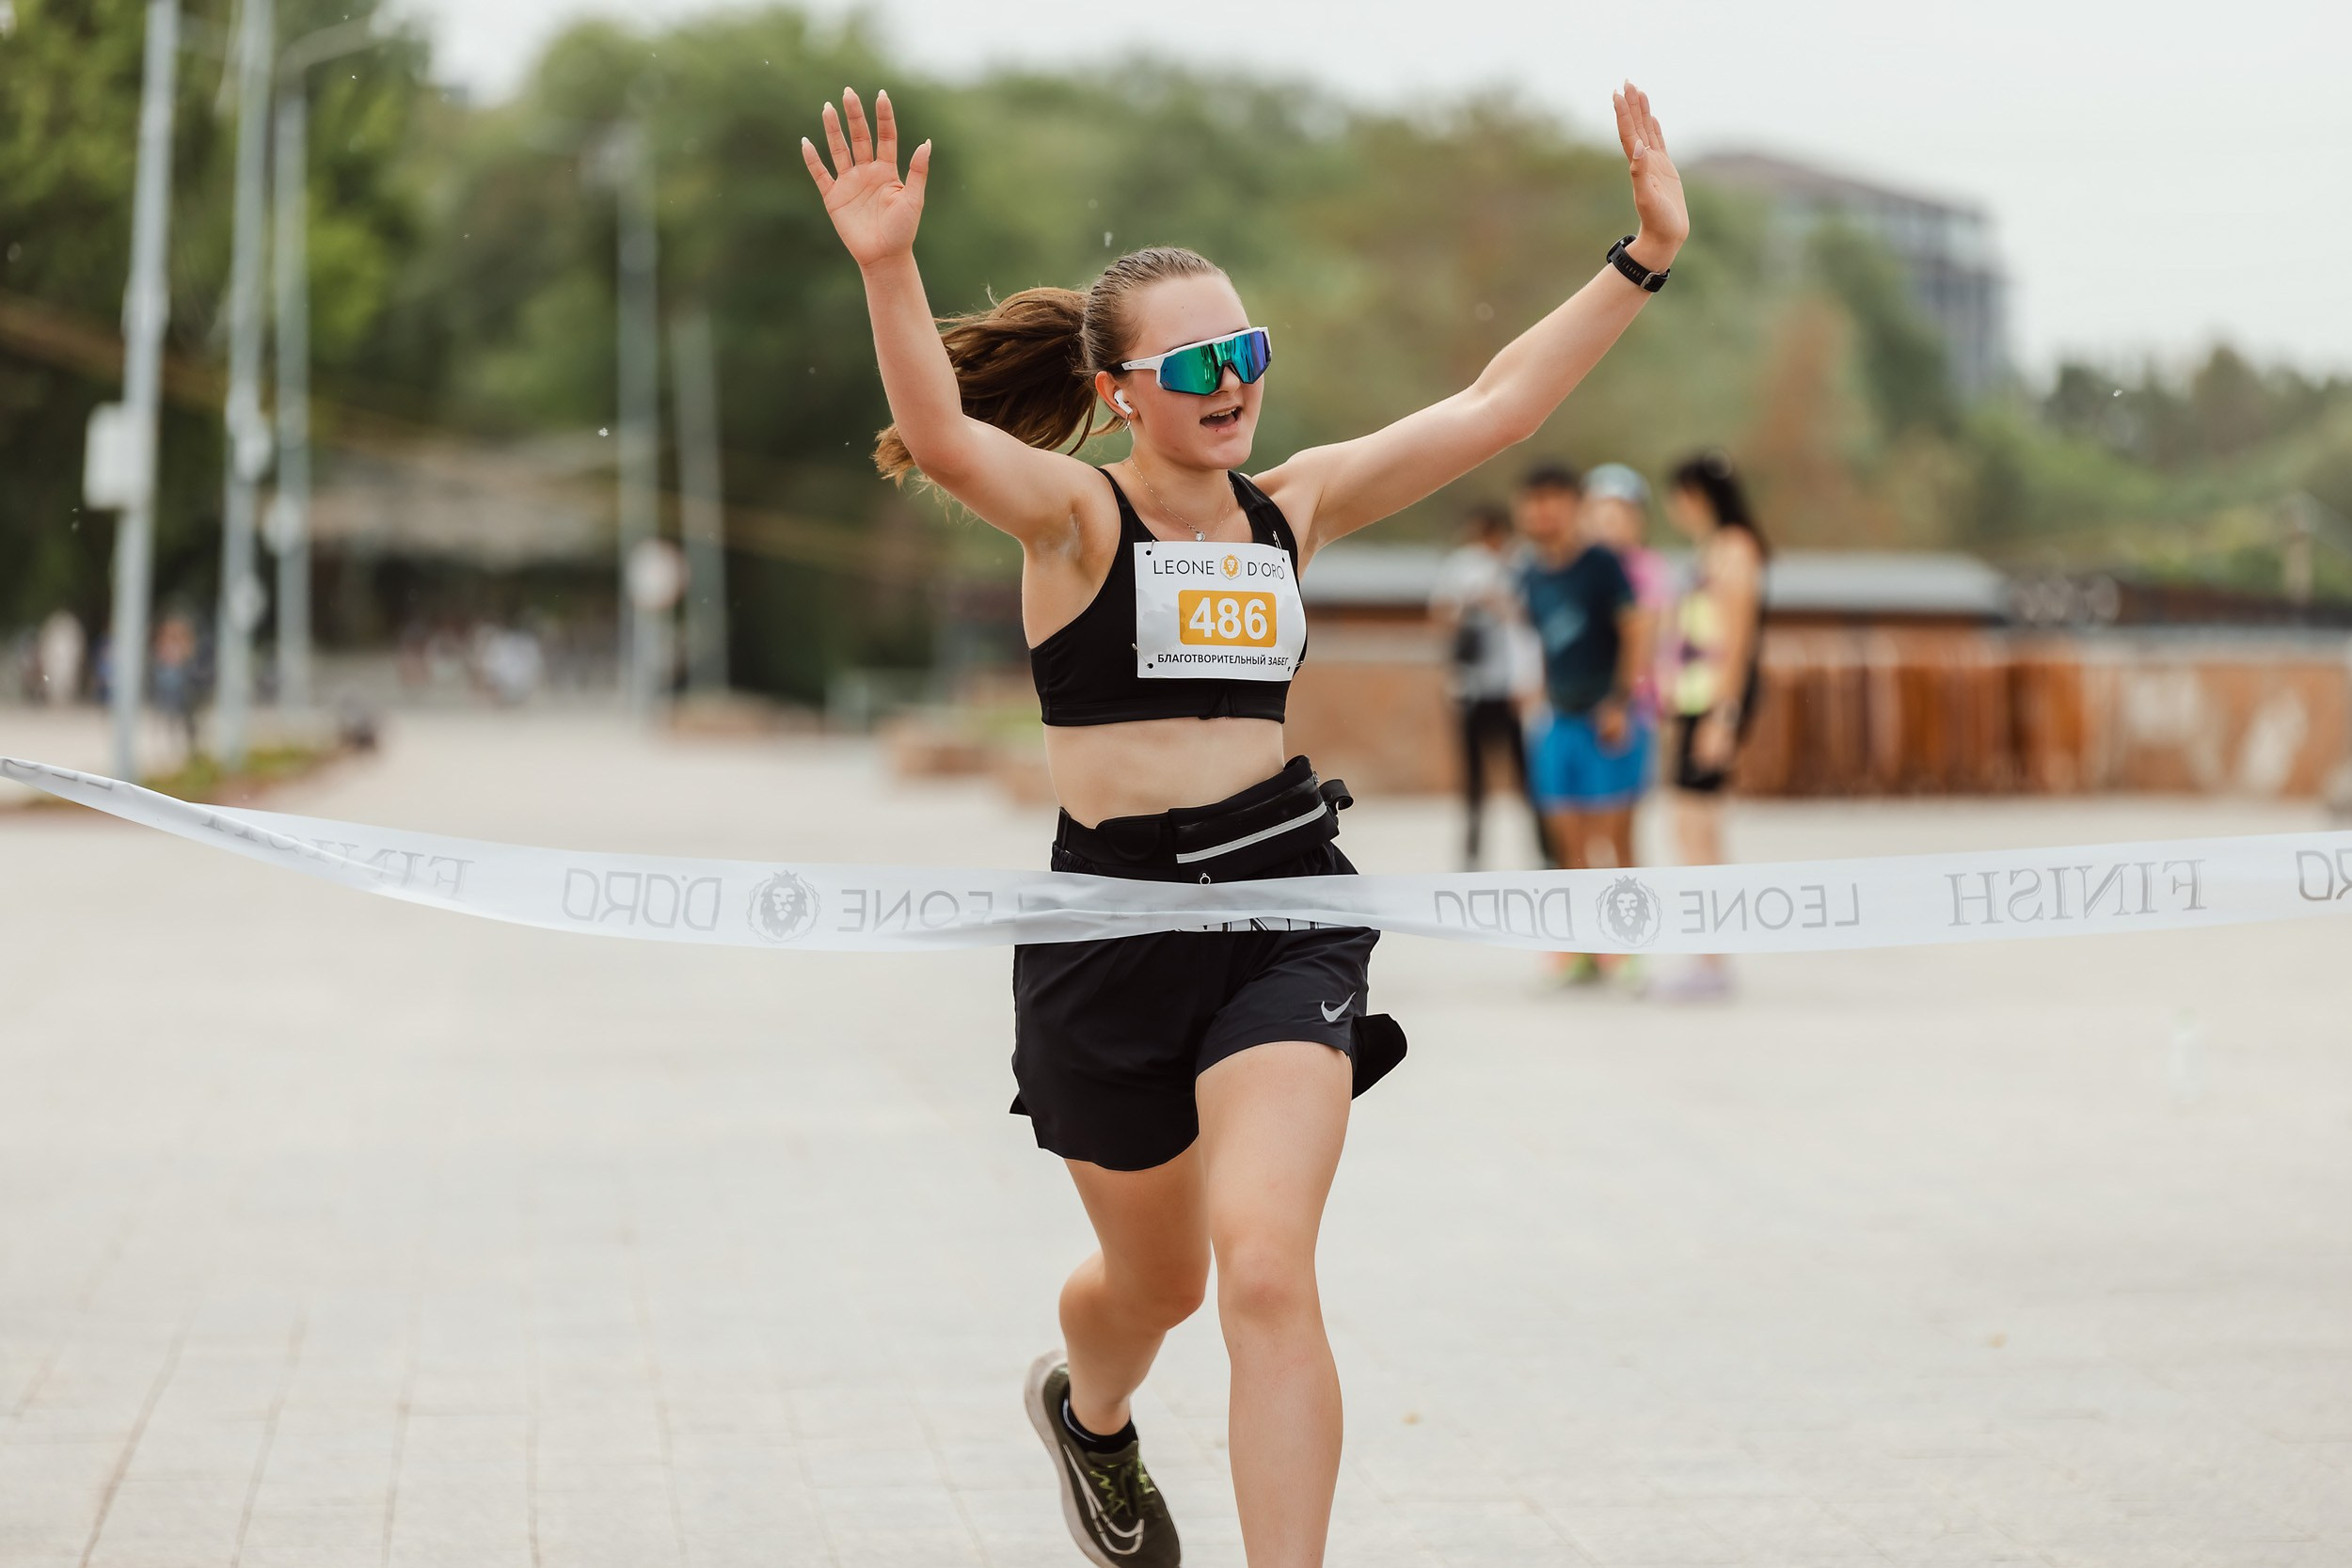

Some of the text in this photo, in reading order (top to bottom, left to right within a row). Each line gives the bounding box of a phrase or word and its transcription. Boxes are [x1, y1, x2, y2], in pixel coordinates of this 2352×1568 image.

[1153, 560, 1285, 579] LEONE D'ORO
[1189, 597, 1268, 640] 486
[1157, 654, 1290, 666] БЛАГОТВОРИТЕЛЬНЫЙ ЗАБЕГ
